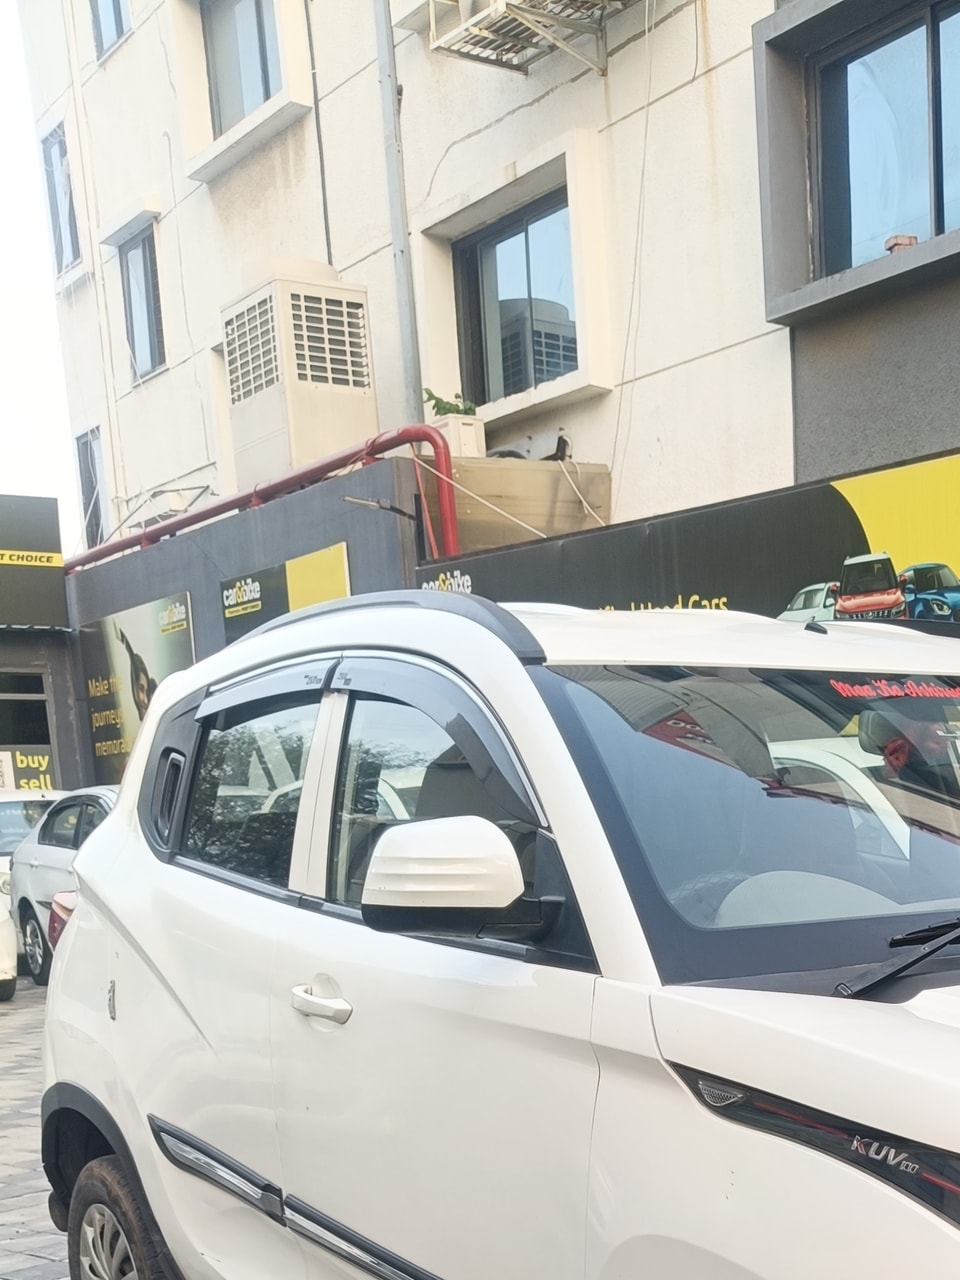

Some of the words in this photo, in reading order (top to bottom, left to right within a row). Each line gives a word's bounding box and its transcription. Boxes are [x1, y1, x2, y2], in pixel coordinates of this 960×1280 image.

[8, 553, 55, 564] CHOICE
[223, 578, 261, 606] car&bike
[88, 676, 109, 697] Make
[15, 750, 49, 771] buy
[20, 774, 53, 790] sell
